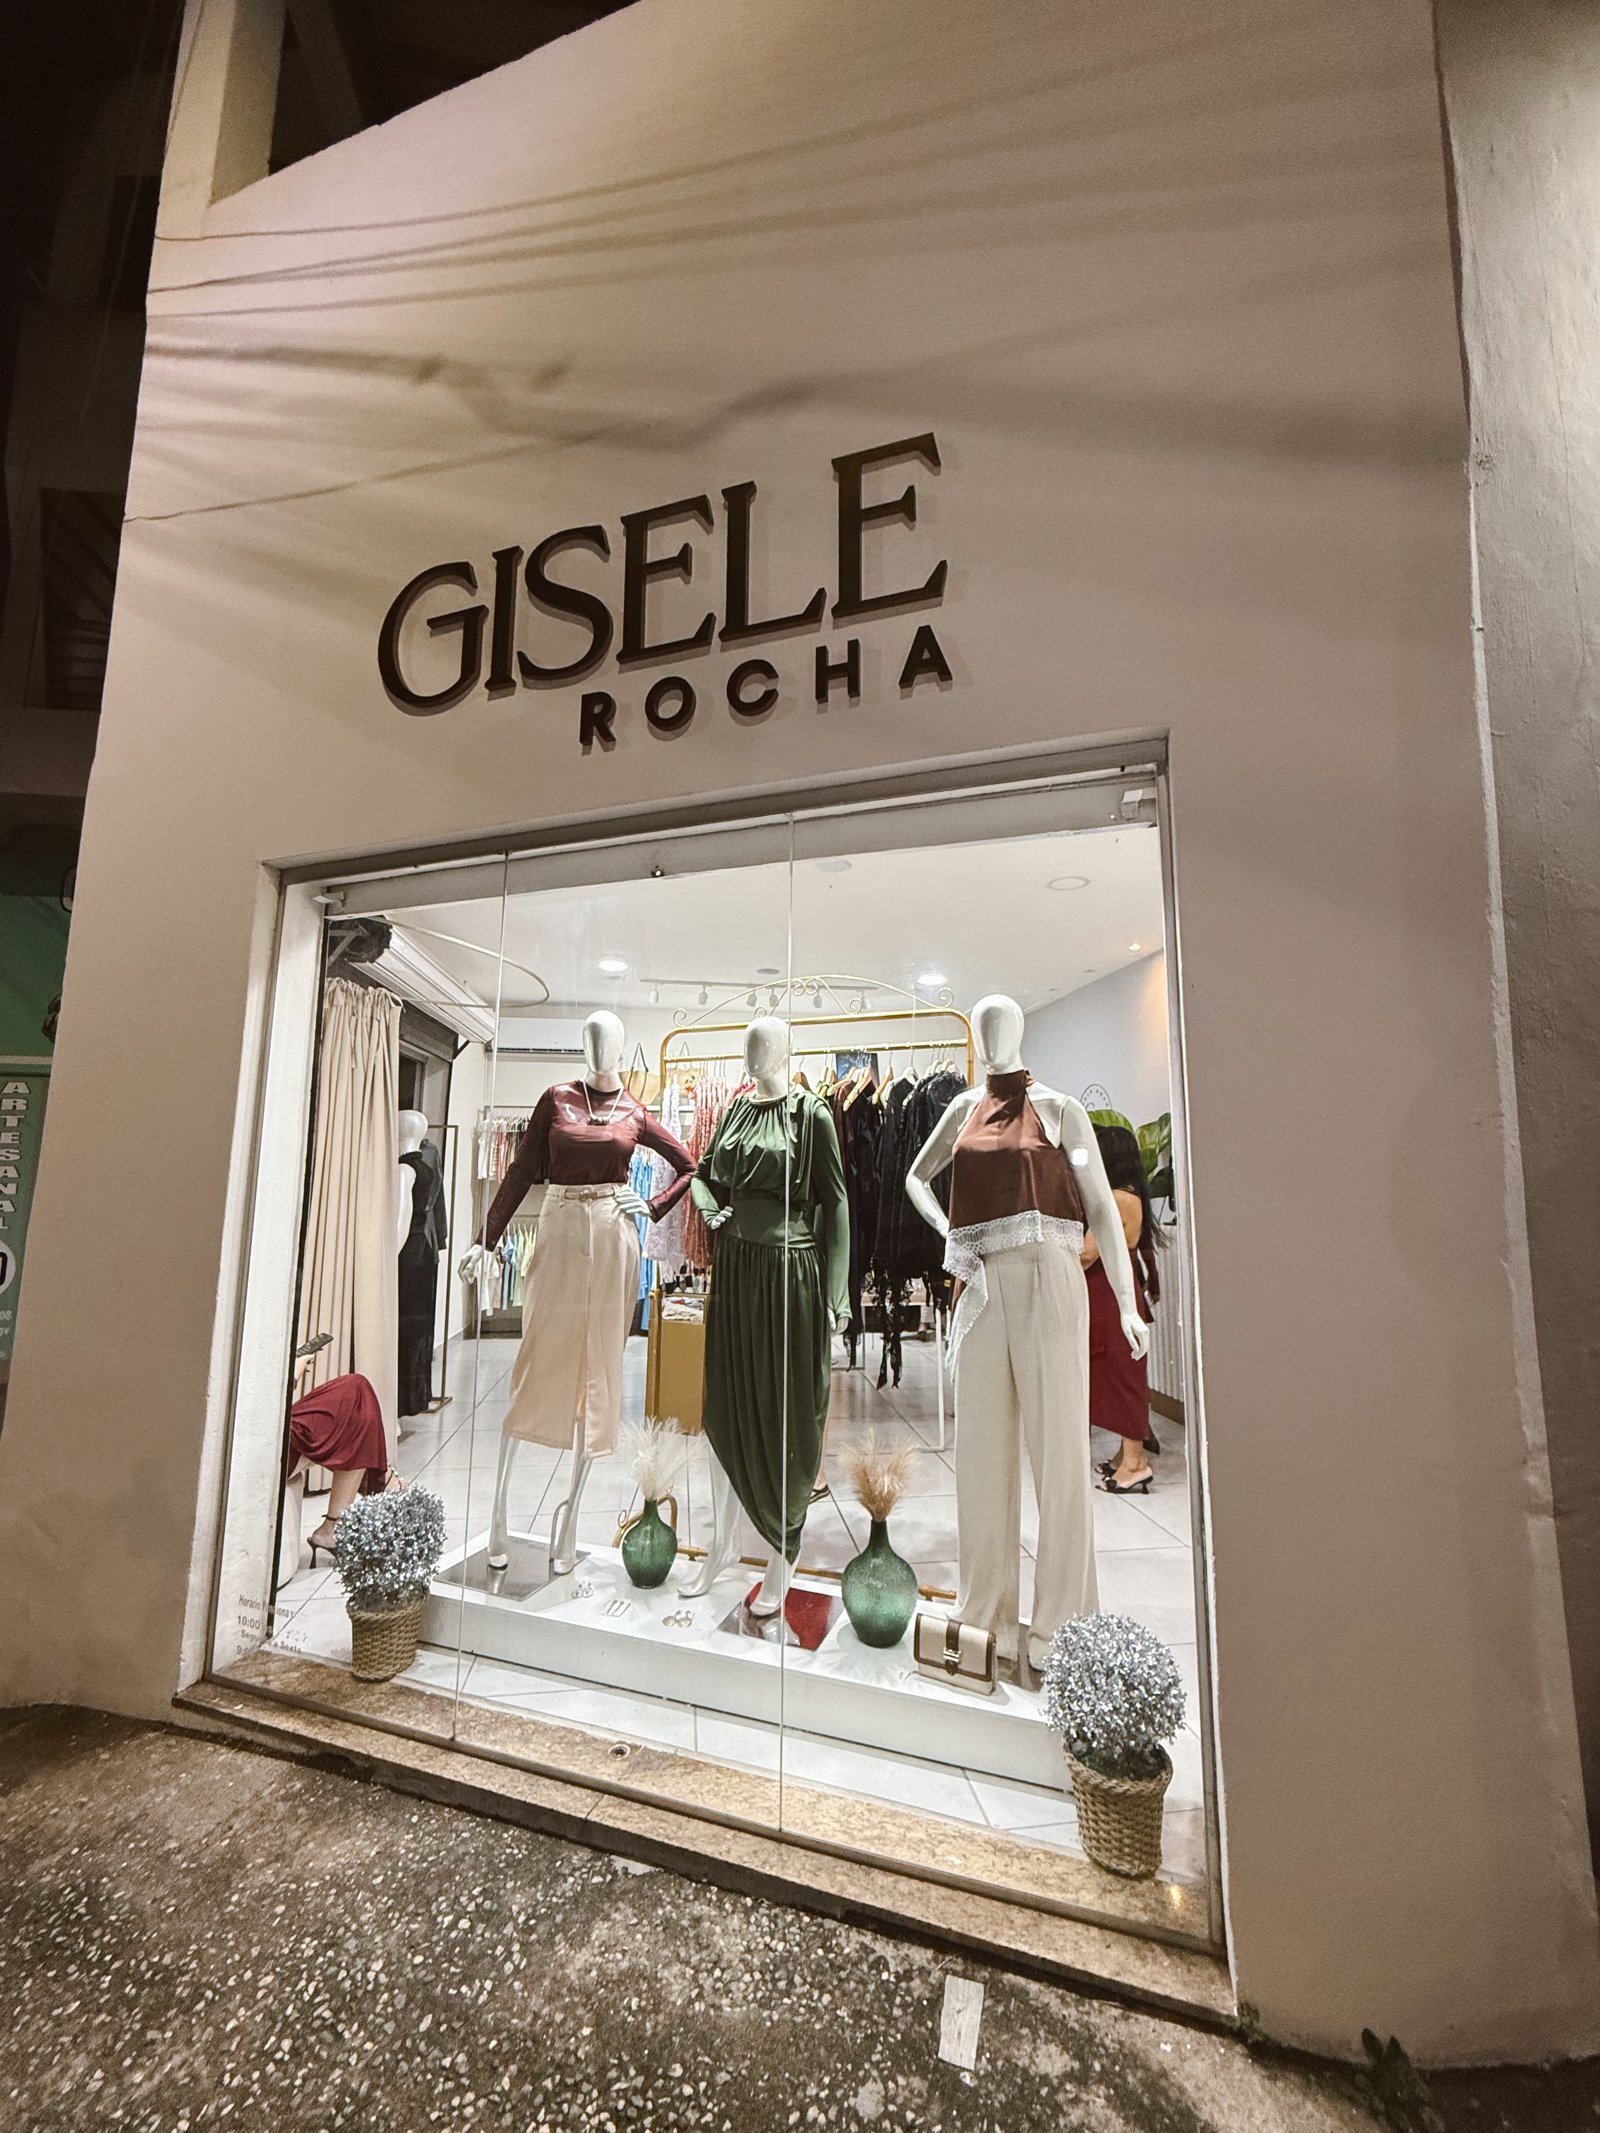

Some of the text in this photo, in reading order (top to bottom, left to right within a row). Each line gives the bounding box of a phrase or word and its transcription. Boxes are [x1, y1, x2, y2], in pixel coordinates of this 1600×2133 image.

[377, 432, 948, 710] GISELE
[579, 625, 953, 747] ROCHA
[0, 1082, 30, 1229] ARTESANAL
